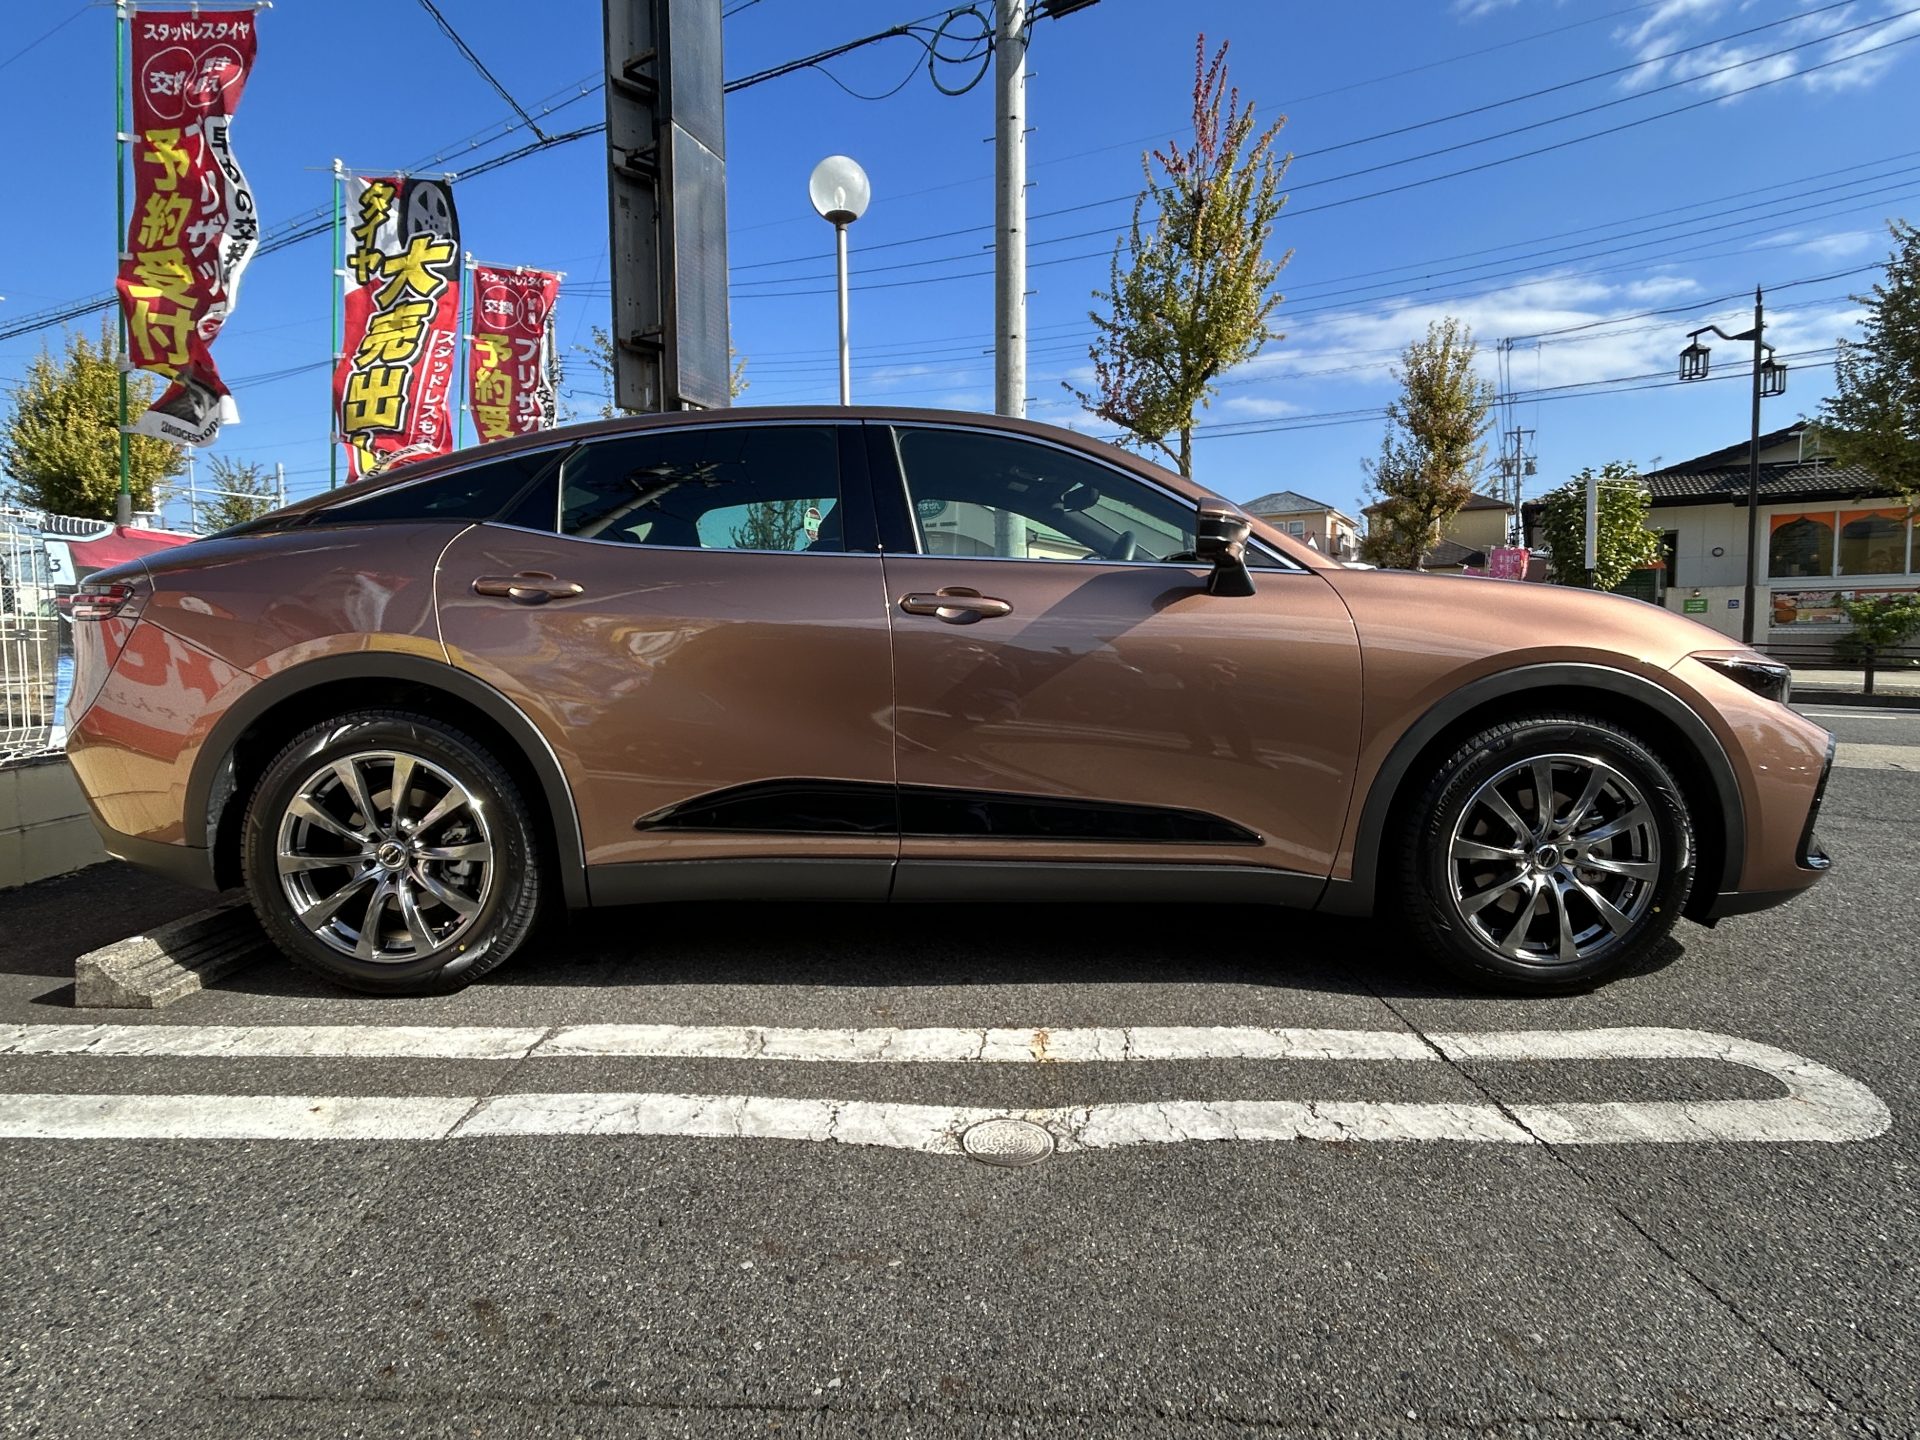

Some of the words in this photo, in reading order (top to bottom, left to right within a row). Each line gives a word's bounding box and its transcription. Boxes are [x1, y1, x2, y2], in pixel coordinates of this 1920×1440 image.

[143, 21, 250, 41] スタッドレスタイヤ
[346, 181, 397, 286] タイヤ
